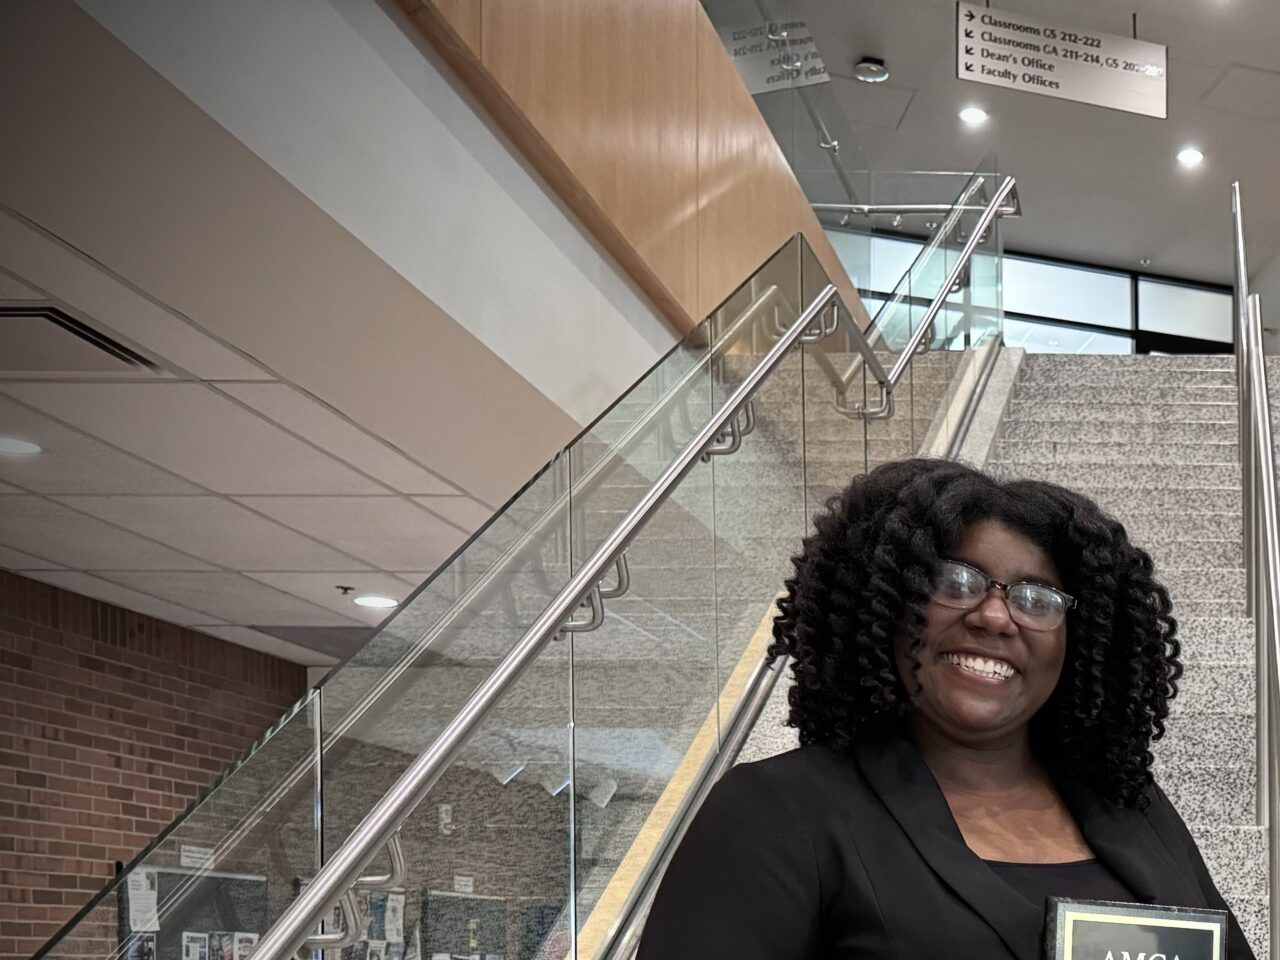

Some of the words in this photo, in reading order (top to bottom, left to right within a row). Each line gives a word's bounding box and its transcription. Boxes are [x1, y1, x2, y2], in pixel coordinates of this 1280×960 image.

[980, 14, 1041, 36] Classrooms
[1060, 31, 1102, 48] 212-222
[980, 31, 1041, 53] Classrooms
[981, 48, 1018, 65] Dean's
[1022, 56, 1055, 72] Office
[981, 64, 1018, 83] Faculty
[1022, 72, 1060, 90] Offices
